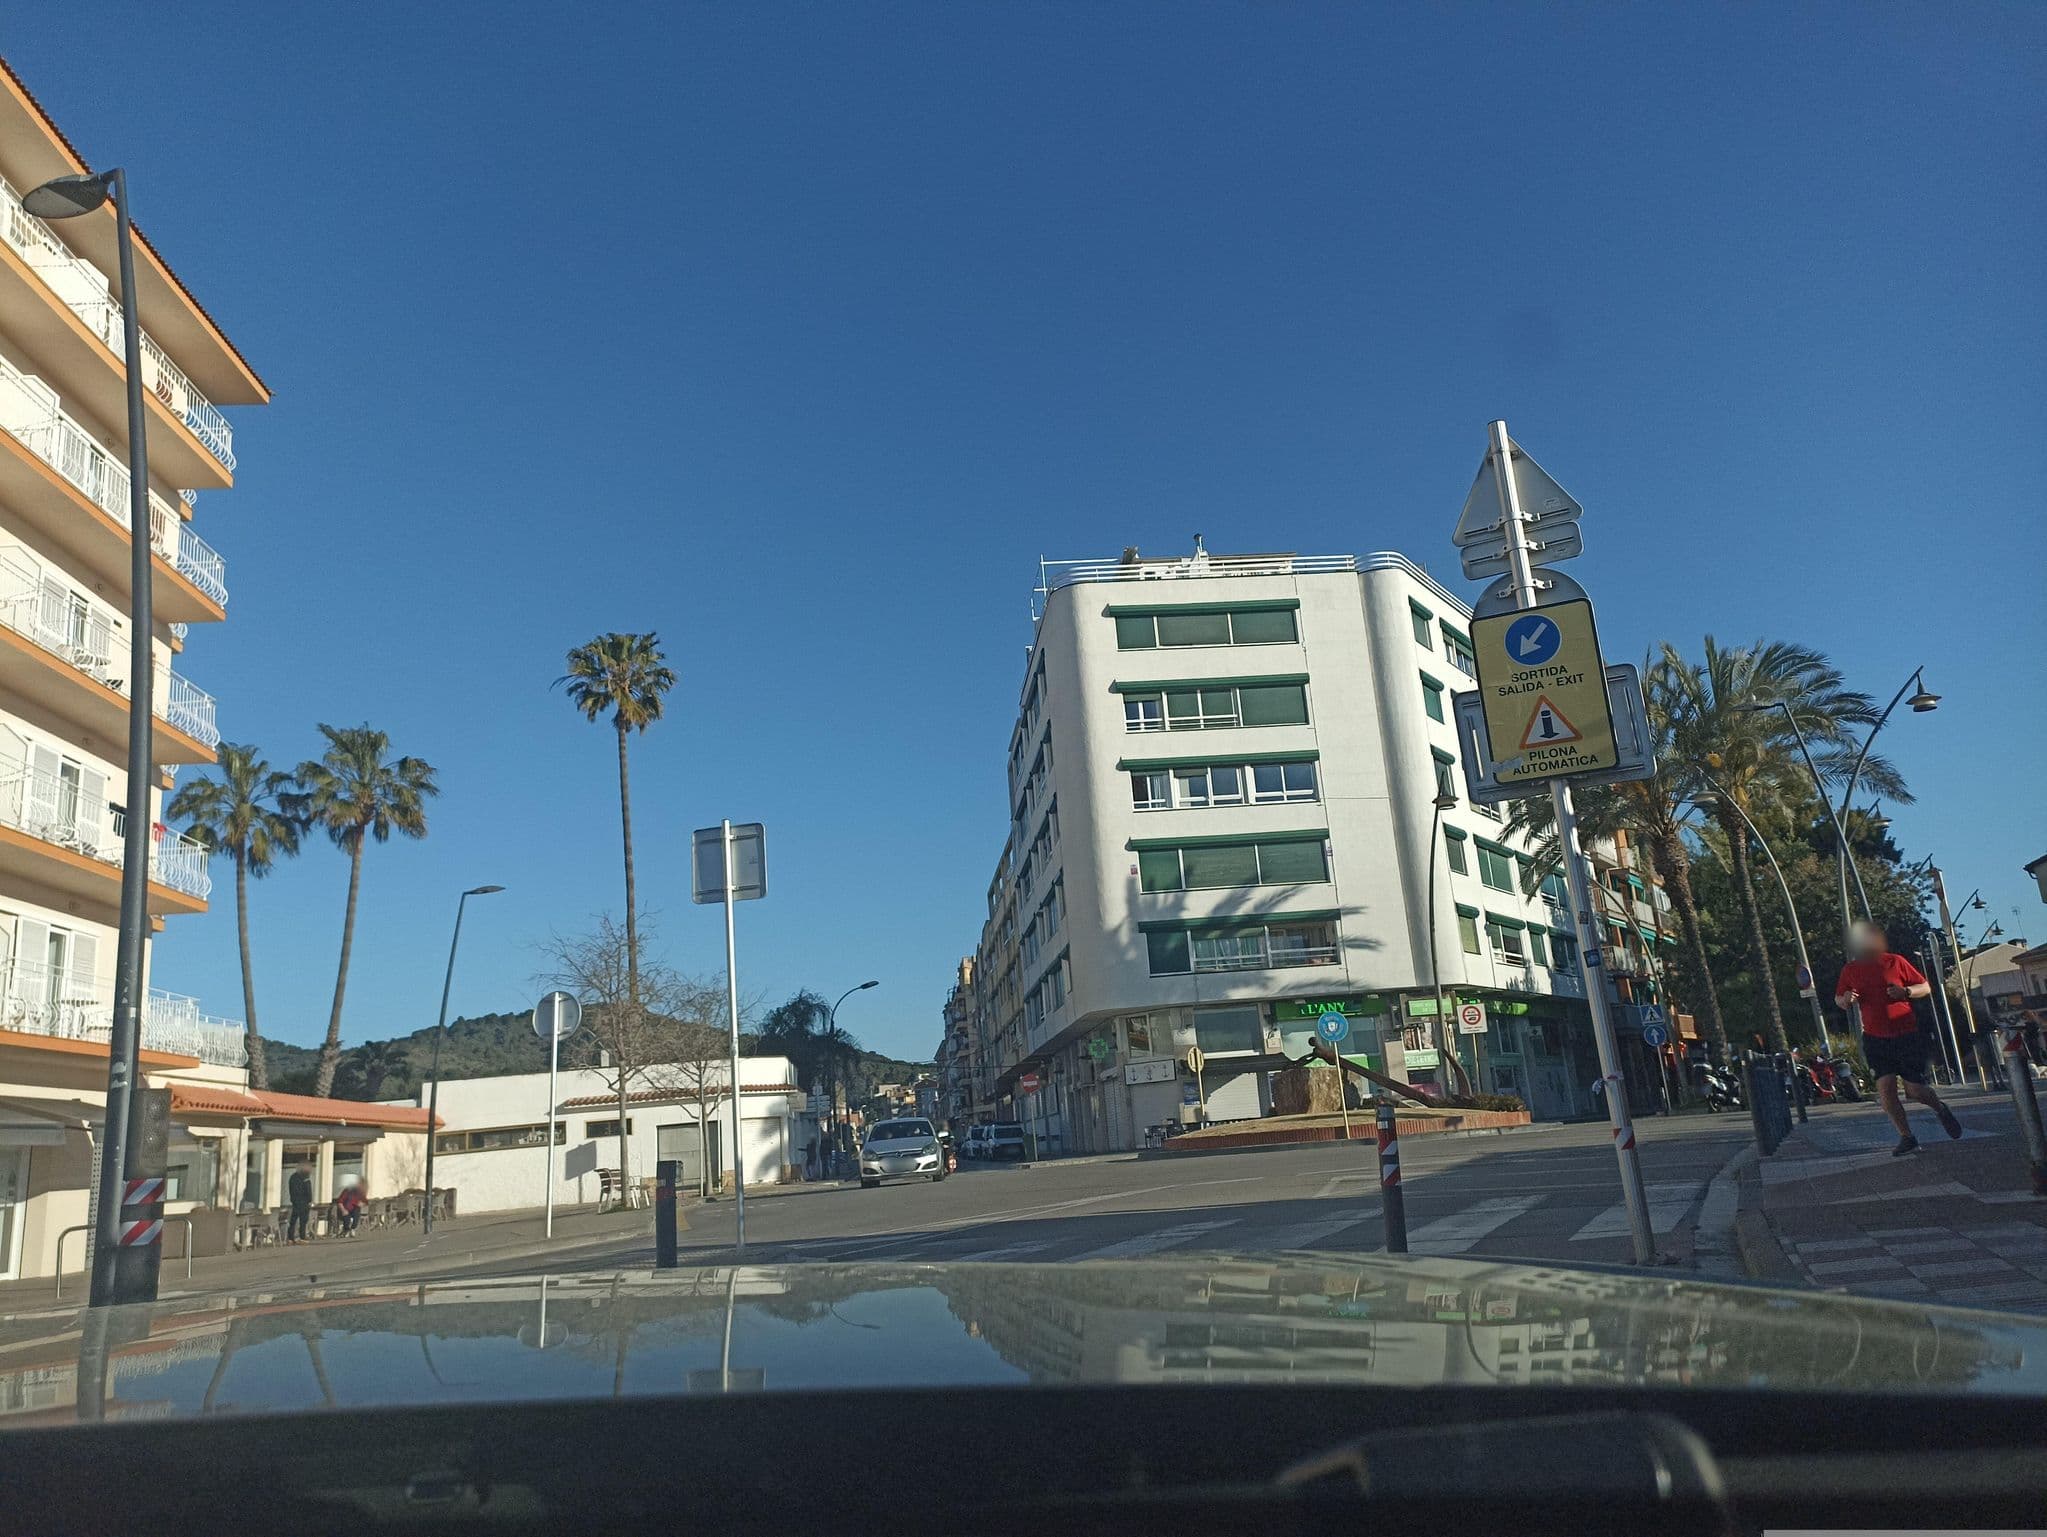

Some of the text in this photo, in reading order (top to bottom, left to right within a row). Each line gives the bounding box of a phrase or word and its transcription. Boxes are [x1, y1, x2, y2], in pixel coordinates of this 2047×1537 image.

[1512, 665, 1568, 683] SORTIDA
[1499, 681, 1544, 696] SALIDA
[1556, 673, 1584, 687] EXIT
[1529, 745, 1577, 761] PILONA
[1513, 754, 1599, 775] AUTOMATICA
